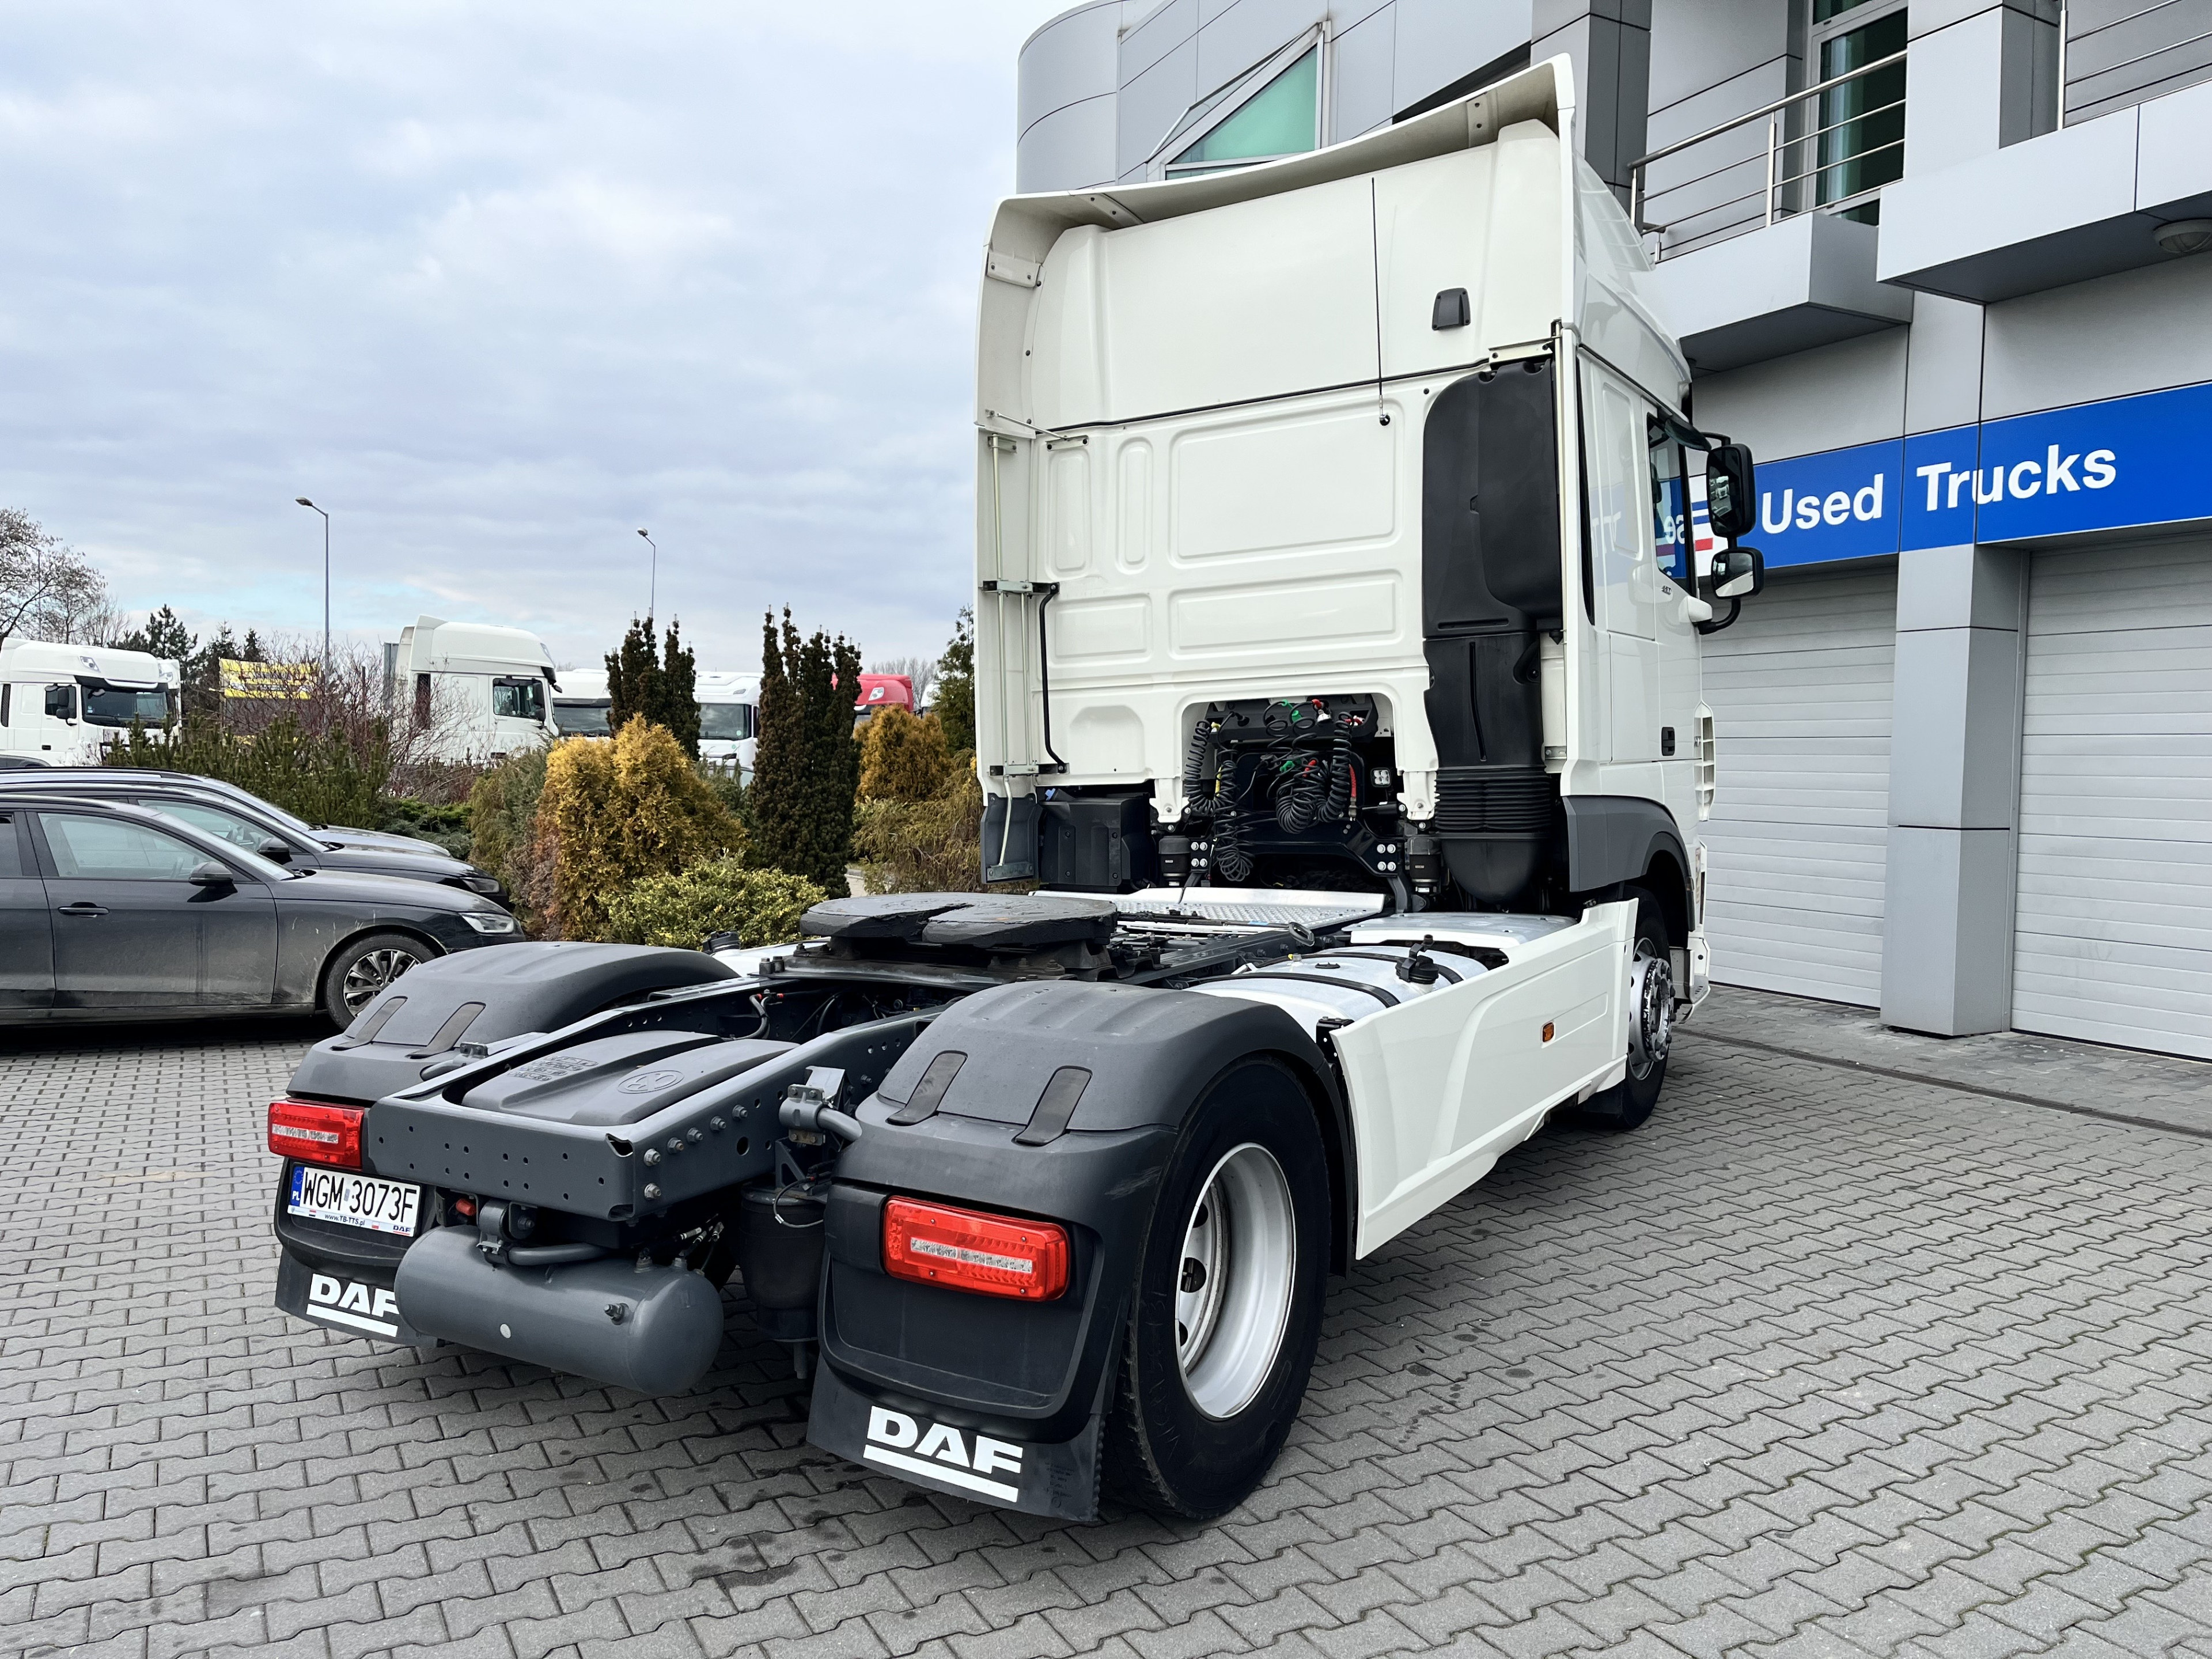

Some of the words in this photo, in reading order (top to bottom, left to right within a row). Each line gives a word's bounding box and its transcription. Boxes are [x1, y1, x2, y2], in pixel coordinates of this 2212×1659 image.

[1762, 473, 1884, 534] Used
[1916, 444, 2116, 512] Trucks
[292, 1190, 300, 1201] PL
[303, 1172, 344, 1211] WGM
[349, 1180, 417, 1223] 3073F
[324, 1214, 365, 1228] www.TB-TTS.pl
[309, 1274, 400, 1317] DAF
[867, 1406, 1023, 1474] DAF
